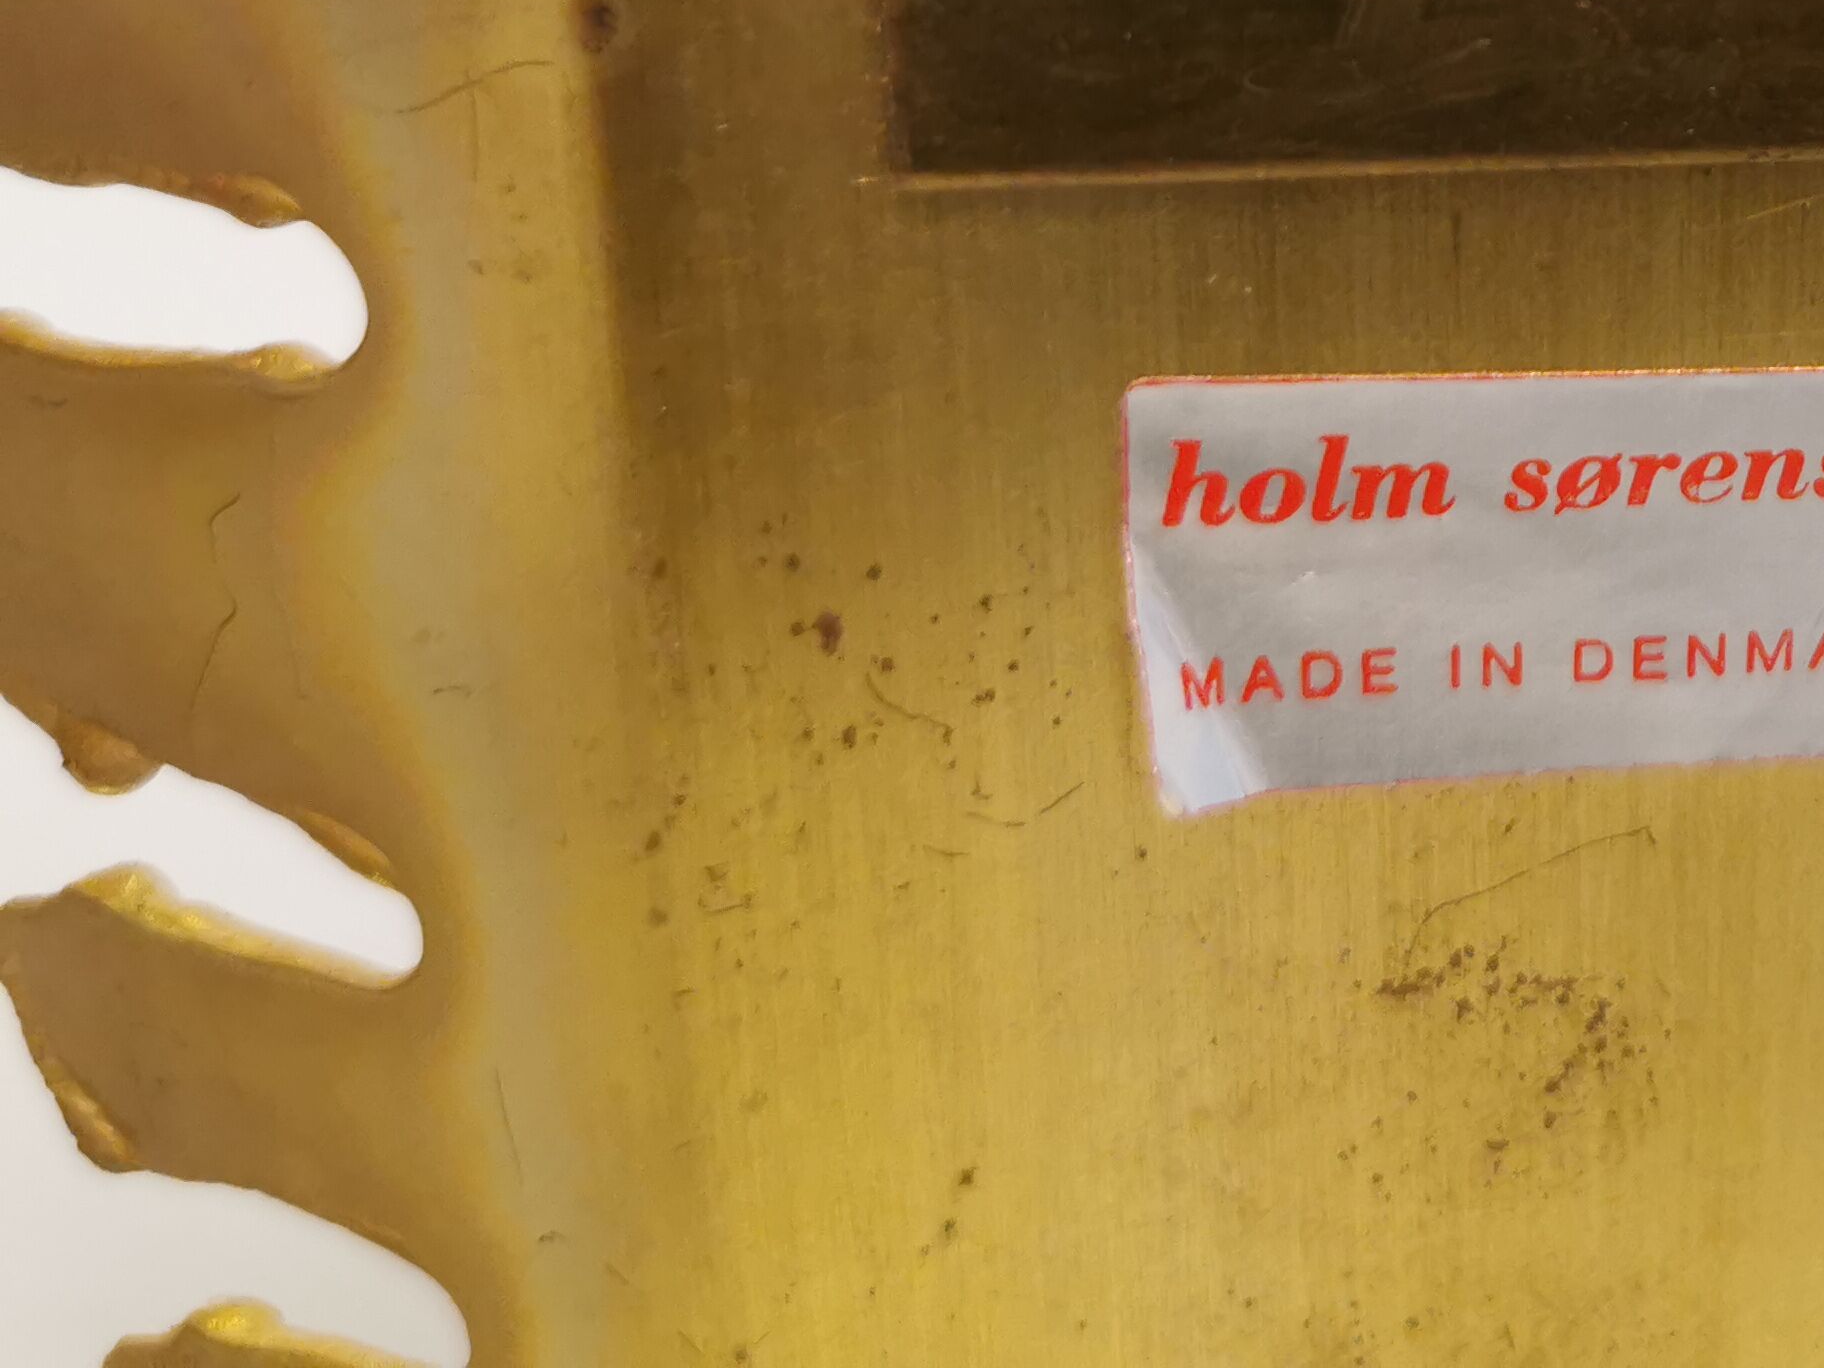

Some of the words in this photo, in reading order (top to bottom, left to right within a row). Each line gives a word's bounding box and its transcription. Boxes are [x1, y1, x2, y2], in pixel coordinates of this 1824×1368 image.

[1160, 433, 1457, 529] holm
[1180, 645, 1398, 713] MADE
[1448, 642, 1525, 692] IN
